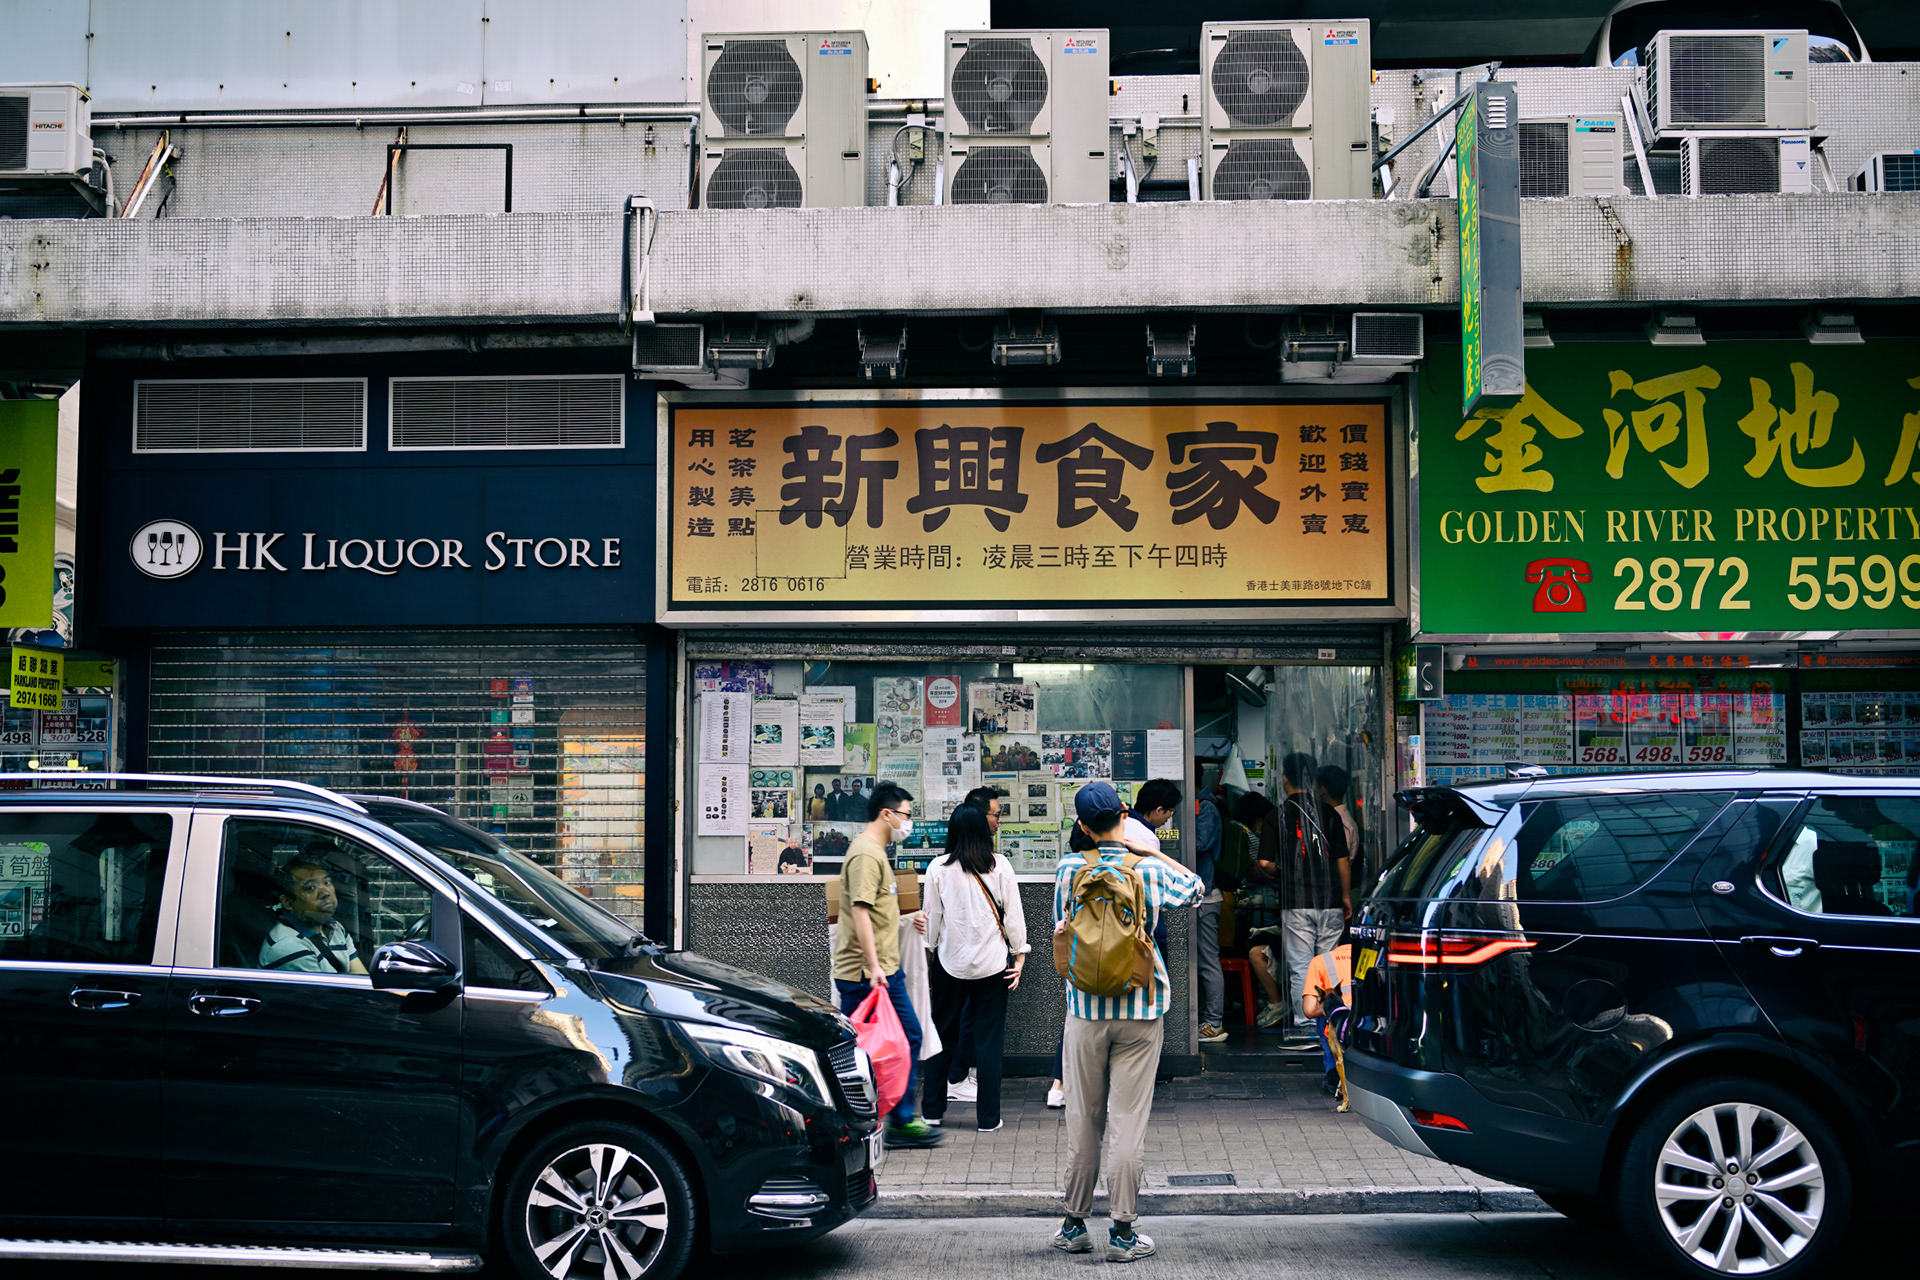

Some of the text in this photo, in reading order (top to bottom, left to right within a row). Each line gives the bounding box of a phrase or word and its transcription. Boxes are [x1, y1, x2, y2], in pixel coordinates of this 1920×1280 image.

[1457, 104, 1476, 145] GOLDEN
[1460, 126, 1473, 160] RIVER
[687, 428, 716, 538] 用心製造
[727, 427, 757, 537] 茗茶美點
[779, 421, 1280, 533] 新興食家
[1298, 424, 1329, 535] 歡迎外賣
[1339, 423, 1370, 535] 價錢實惠
[1440, 506, 1920, 544] GOLDEN RIVER PROPERTY
[212, 531, 288, 572] HK
[983, 543, 1228, 570] 凌晨三時至下午四時
[741, 577, 778, 593] 2816
[787, 577, 825, 593] 0616
[1613, 554, 1920, 611] 2872 5599
[1494, 655, 1626, 668] www.golden-river.com.hk
[14, 674, 60, 691] PARKLAND PROPERTY
[16, 691, 57, 707] 2974 1668
[2, 732, 31, 744] 498
[77, 731, 105, 742] 528
[1581, 747, 1618, 762] 568
[1636, 746, 1673, 762] 498
[1688, 746, 1726, 762] 598
